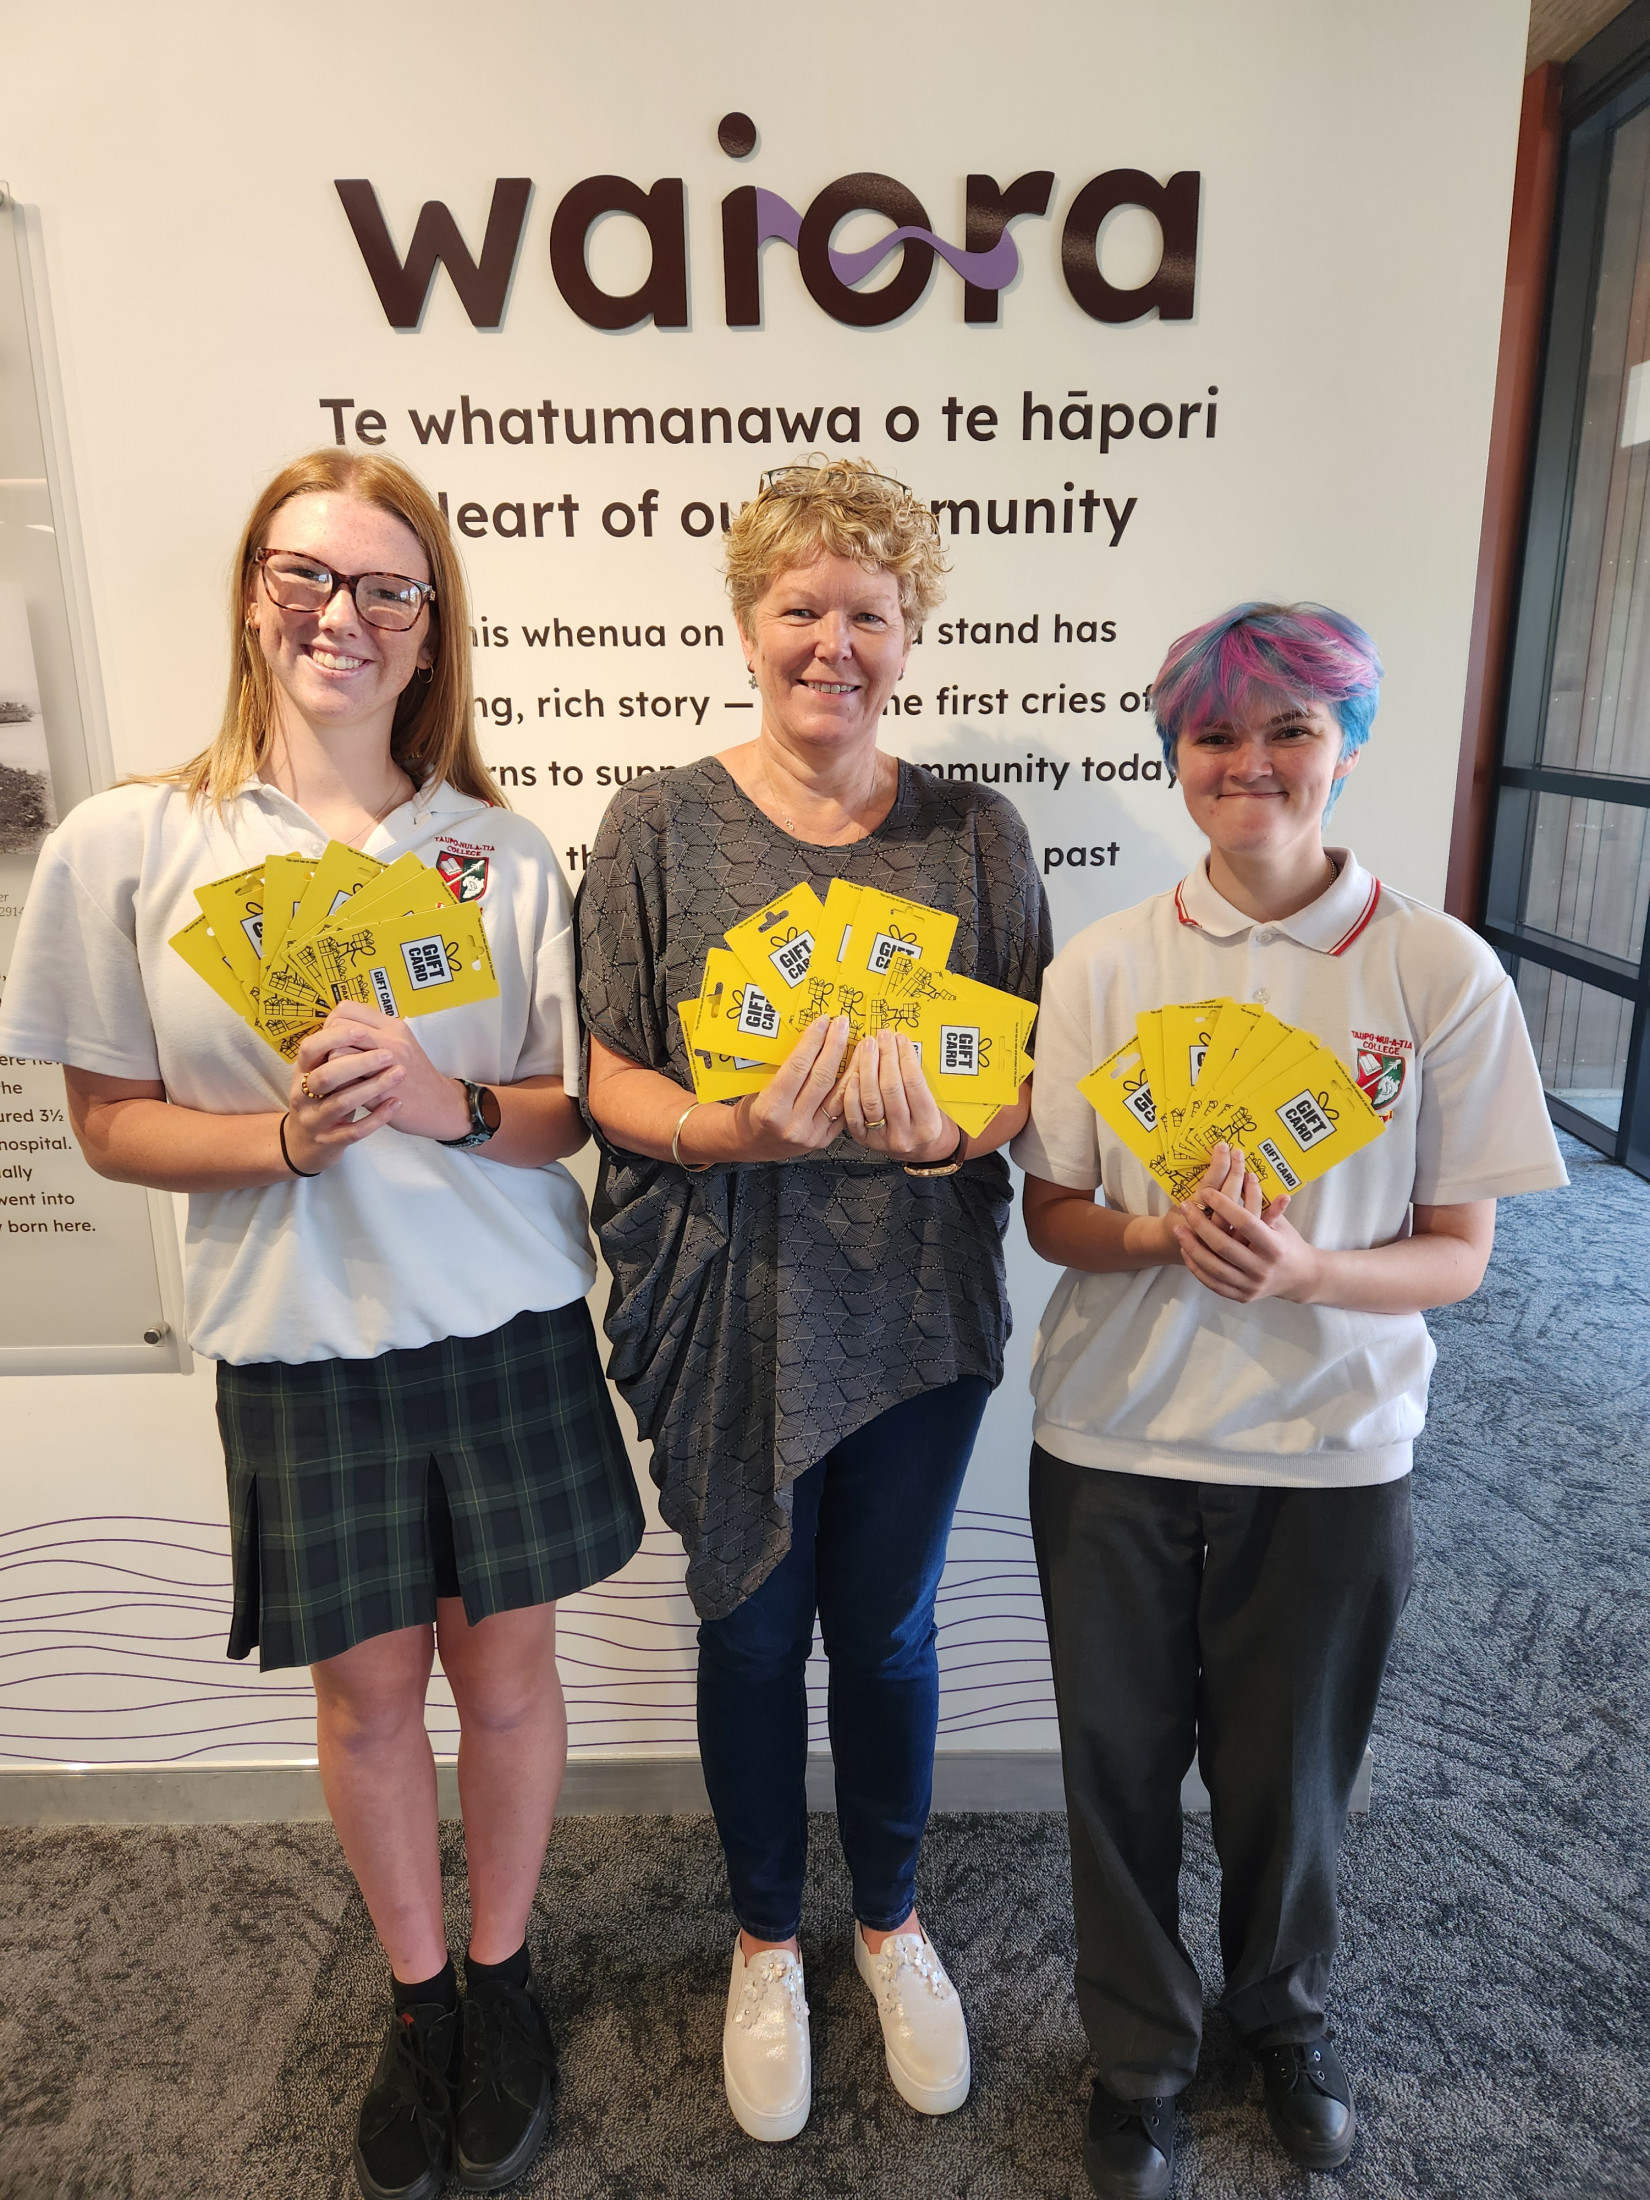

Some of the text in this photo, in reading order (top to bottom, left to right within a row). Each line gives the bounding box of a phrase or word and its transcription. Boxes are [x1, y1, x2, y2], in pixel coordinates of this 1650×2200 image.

[334, 111, 1203, 331] waiora
[319, 385, 1219, 454] Te whatumanawa o te hāpori
[602, 489, 659, 537] of
[931, 481, 1138, 547] munity
[522, 618, 666, 647] whenua
[680, 624, 724, 647] on
[938, 614, 1039, 645] stand
[1054, 613, 1117, 643] has
[538, 687, 604, 717] rich
[618, 691, 710, 725] story
[937, 685, 1009, 715] first
[1021, 683, 1106, 714] cries
[549, 761, 584, 786] to
[446, 845, 482, 857] COLLEGE
[1044, 842, 1120, 874] past
[408, 947, 428, 982] CARD
[422, 944, 445, 977] GIFT
[780, 940, 811, 968] GIFT
[788, 956, 811, 979] CAR
[374, 971, 387, 990] GIFT
[746, 992, 765, 1027] GIFT
[762, 997, 776, 1030] CAR
[946, 1032, 957, 1067] CARD
[959, 1033, 973, 1068] GIFT
[1363, 1041, 1400, 1055] COLLEGE
[1285, 1108, 1313, 1142] CARD
[1296, 1100, 1327, 1133] GIFT
[0, 1165, 33, 1182] ally
[1262, 1143, 1297, 1187] GIFT CARD
[41, 1192, 75, 1205] into
[8, 1220, 48, 1233] born
[53, 1219, 96, 1232] here.
